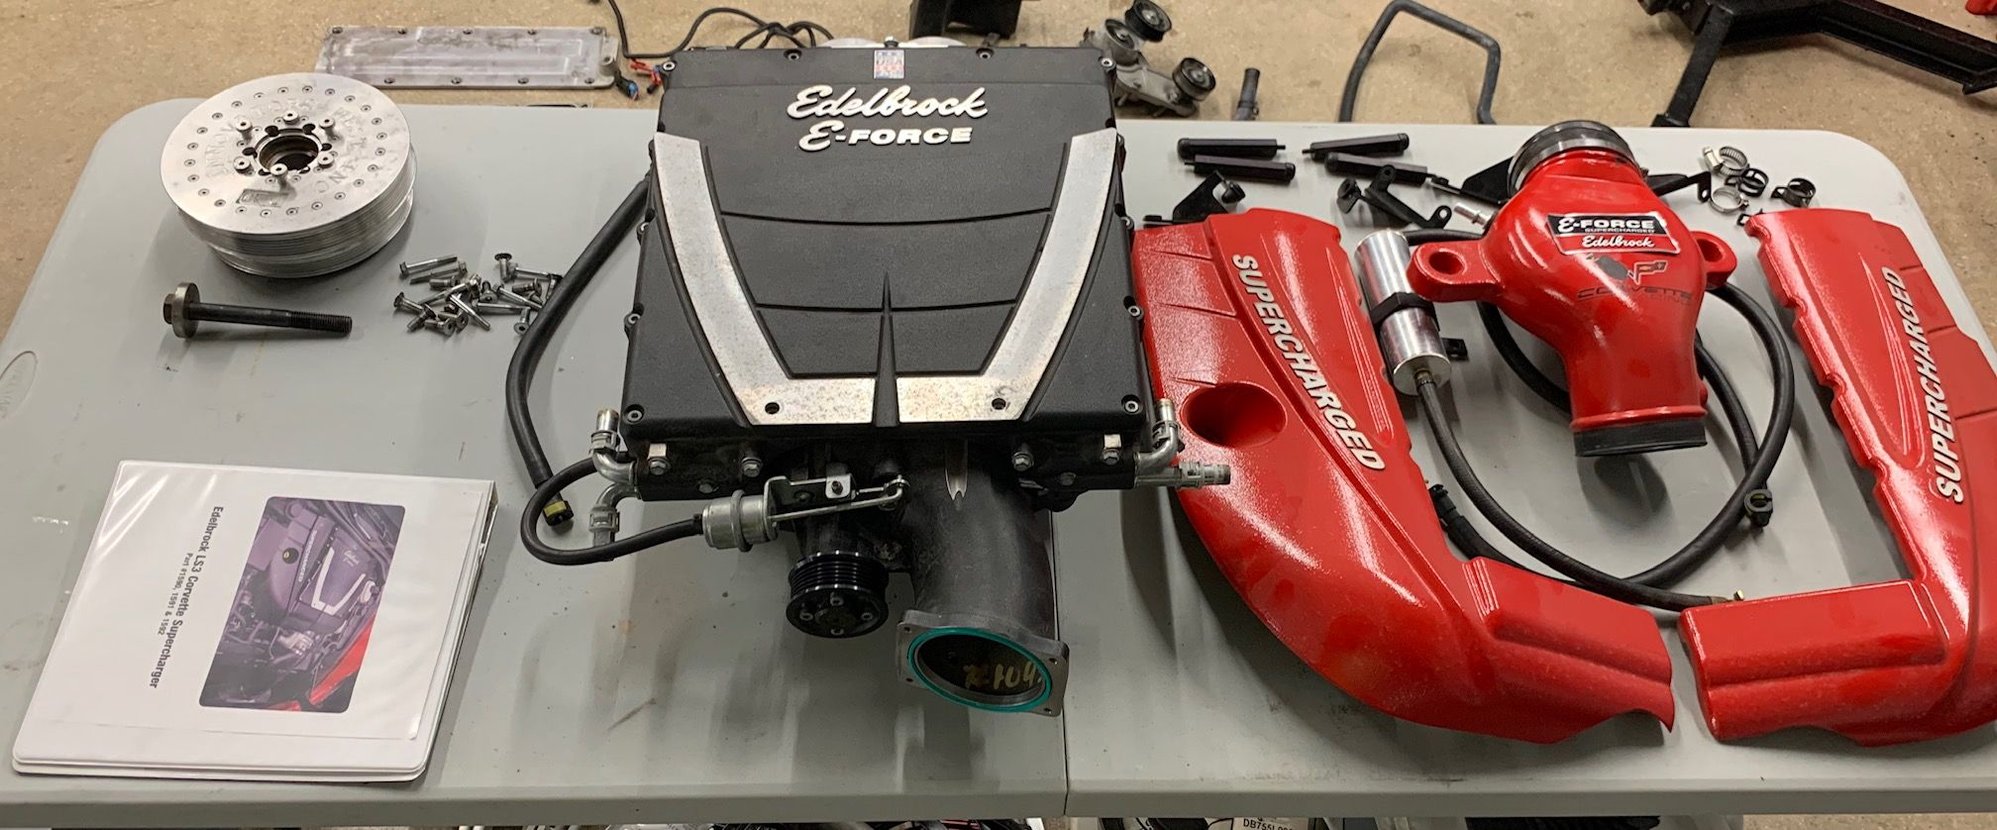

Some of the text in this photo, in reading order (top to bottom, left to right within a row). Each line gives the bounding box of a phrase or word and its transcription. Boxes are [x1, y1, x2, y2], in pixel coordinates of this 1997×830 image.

[786, 84, 989, 119] Edelbrock
[798, 119, 974, 151] E-FORCE
[1557, 216, 1656, 234] E-FORCE
[1581, 235, 1656, 249] Edelbrock
[1577, 286, 1693, 299] COVETTE
[1231, 253, 1387, 471] SUPERCHARGED
[1880, 265, 1965, 505] SUPERCHARGED
[183, 552, 194, 566] Part
[149, 506, 224, 689] Edelbrock LS3 Corvette Supercharger
